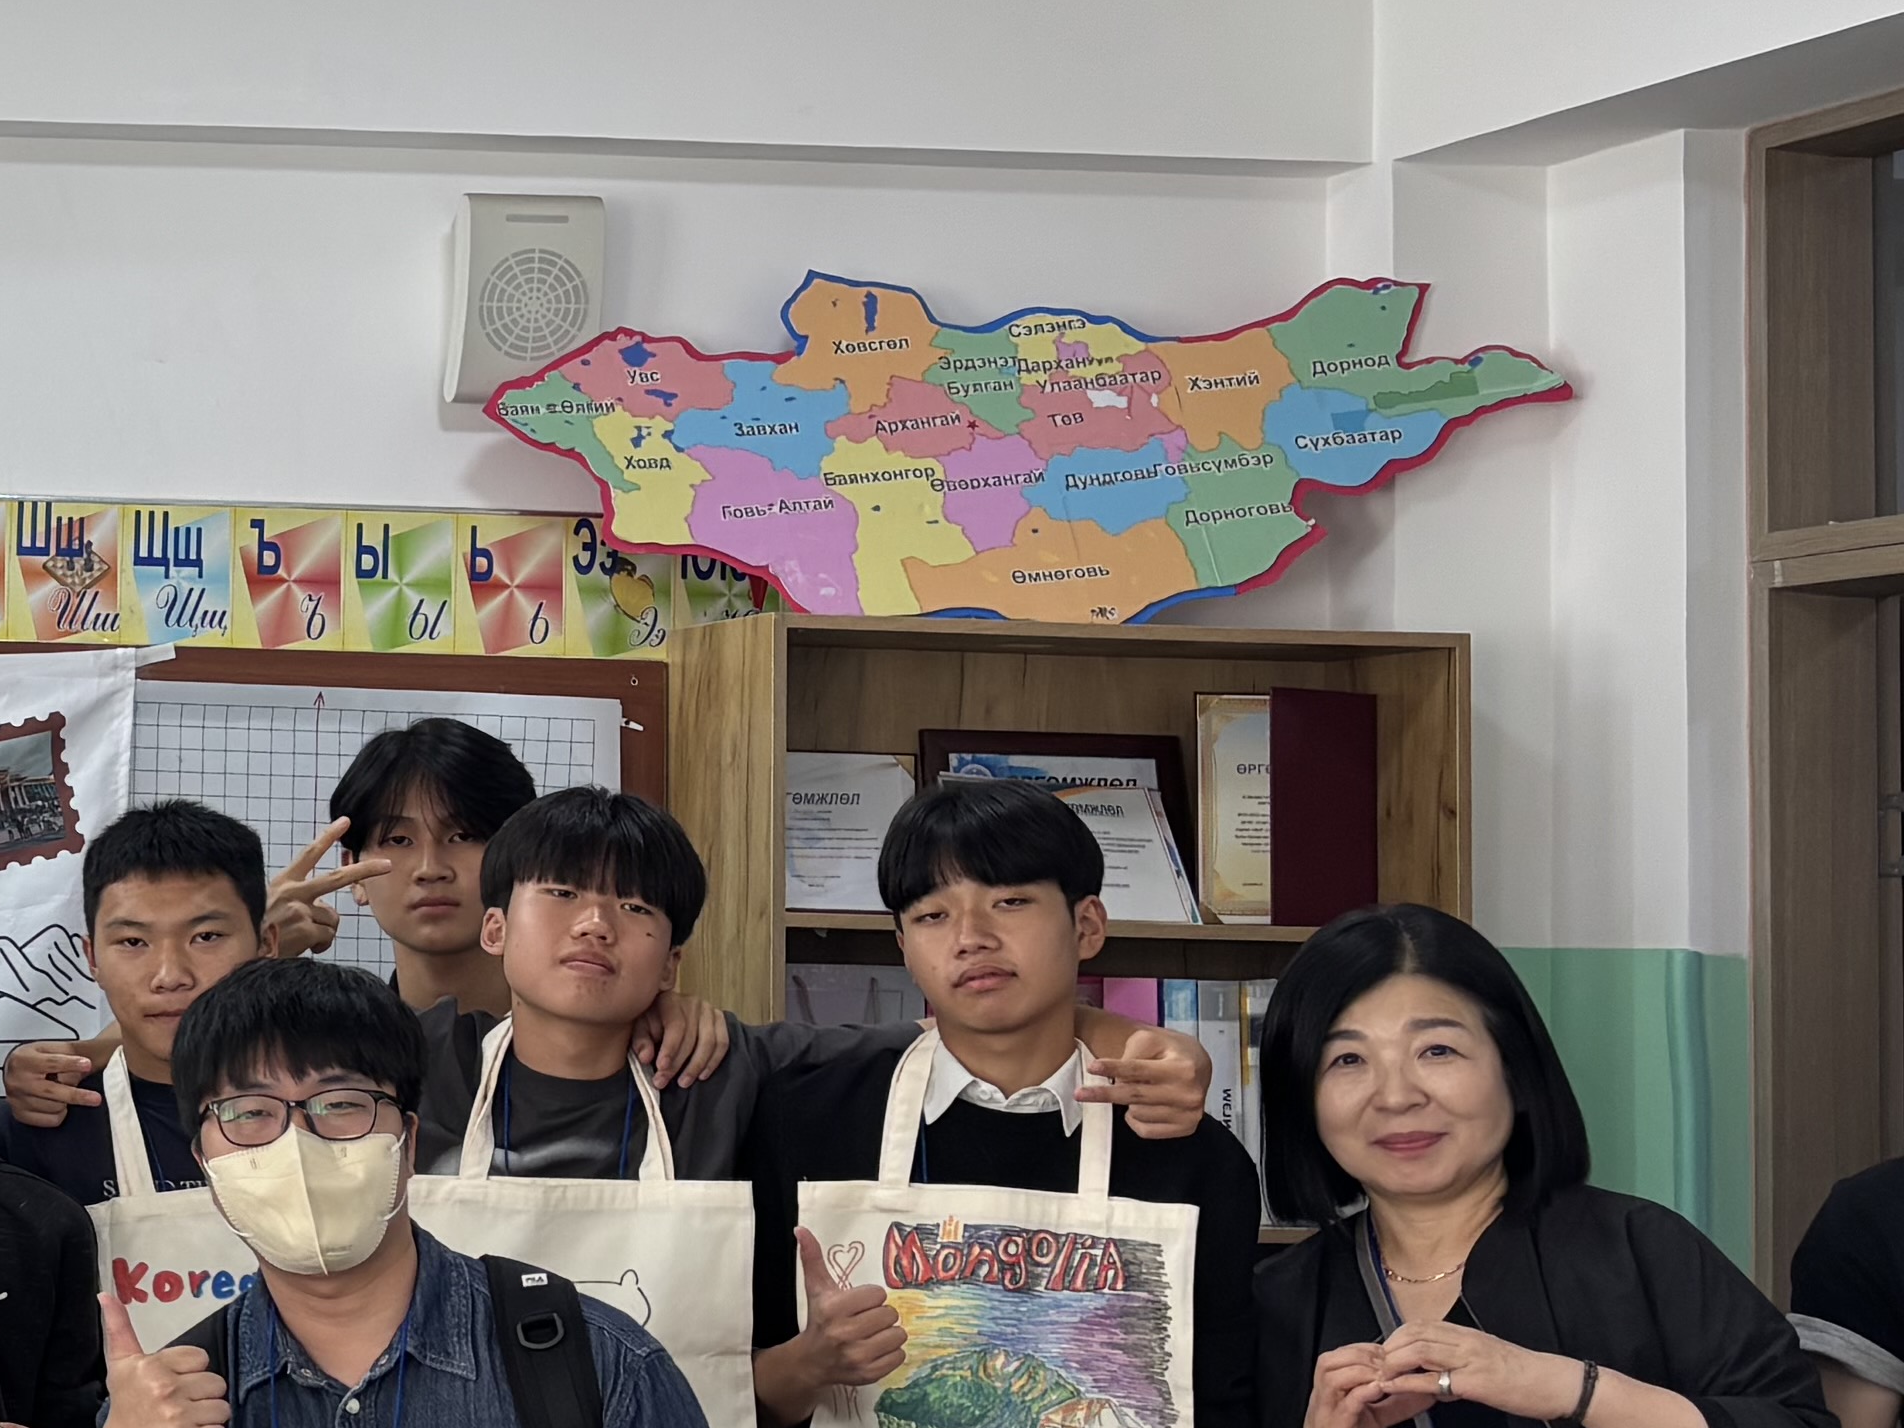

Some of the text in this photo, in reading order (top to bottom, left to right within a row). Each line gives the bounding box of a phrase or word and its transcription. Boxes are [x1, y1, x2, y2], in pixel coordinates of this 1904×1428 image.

[1009, 317, 1087, 339] Сэлэнгэ
[832, 338, 910, 355] Хөвсгөл
[938, 354, 1018, 371] Эрдэнэт
[1311, 354, 1391, 378] Дорнод
[627, 368, 660, 386] Увс
[947, 378, 1015, 398] Булган
[1035, 368, 1162, 394] Улаанбаатар
[1187, 371, 1260, 393] Хэнтий
[733, 420, 800, 436] Завхан
[874, 412, 962, 435] Архангай
[1048, 411, 1084, 429] Төв
[1294, 426, 1403, 451] Сүхбаатар
[624, 455, 672, 472] Ховд
[823, 465, 936, 488] Баянхонгор
[930, 469, 1046, 494] Өвөрхангай
[1064, 467, 1155, 492] Дундговь
[1184, 501, 1294, 527] Дорноговь
[17, 502, 85, 557] Шш
[134, 510, 203, 569] Щщ
[1011, 563, 1111, 585] Өмнөговь
